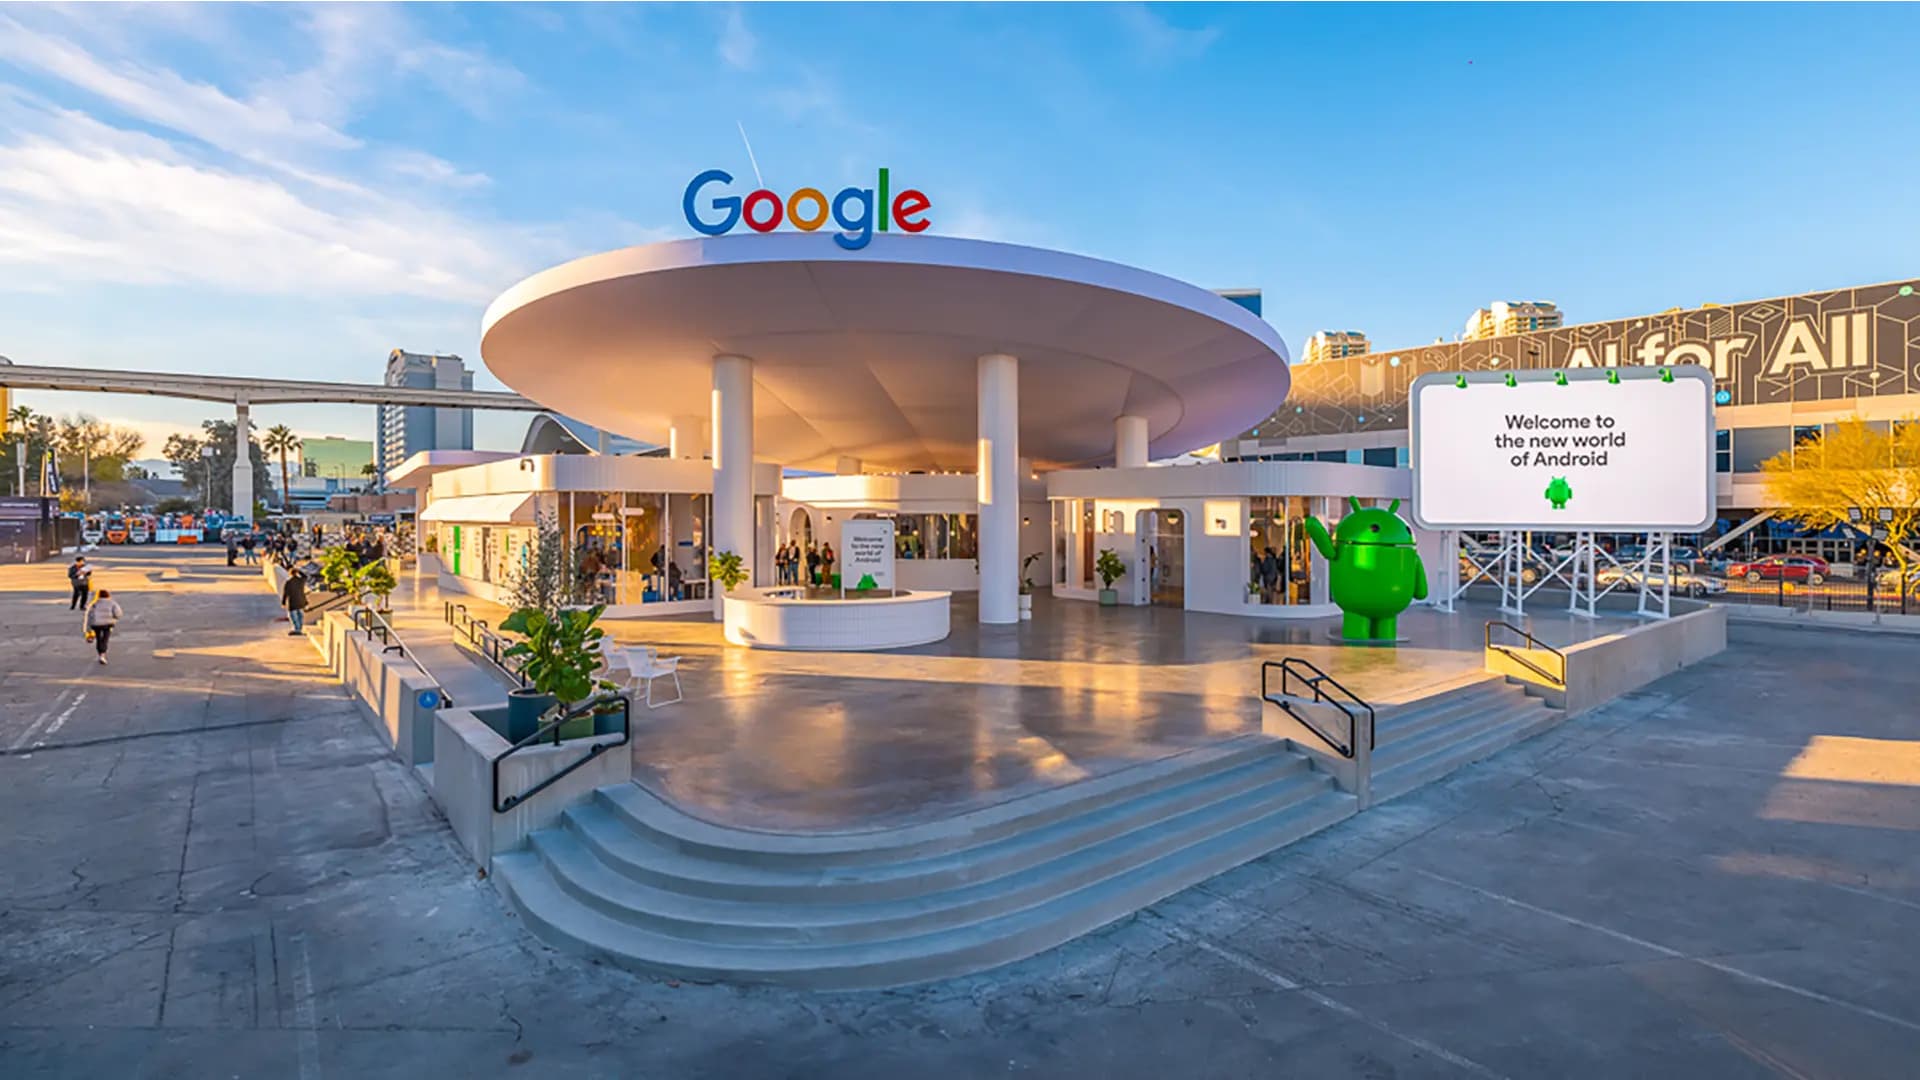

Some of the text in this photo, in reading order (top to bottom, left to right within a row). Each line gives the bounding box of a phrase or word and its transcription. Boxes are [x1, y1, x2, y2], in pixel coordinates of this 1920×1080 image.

[683, 168, 932, 250] Google
[1768, 312, 1868, 375] All
[1505, 414, 1615, 430] Welcome to
[1494, 431, 1626, 448] the new world
[1510, 450, 1608, 467] of Android
